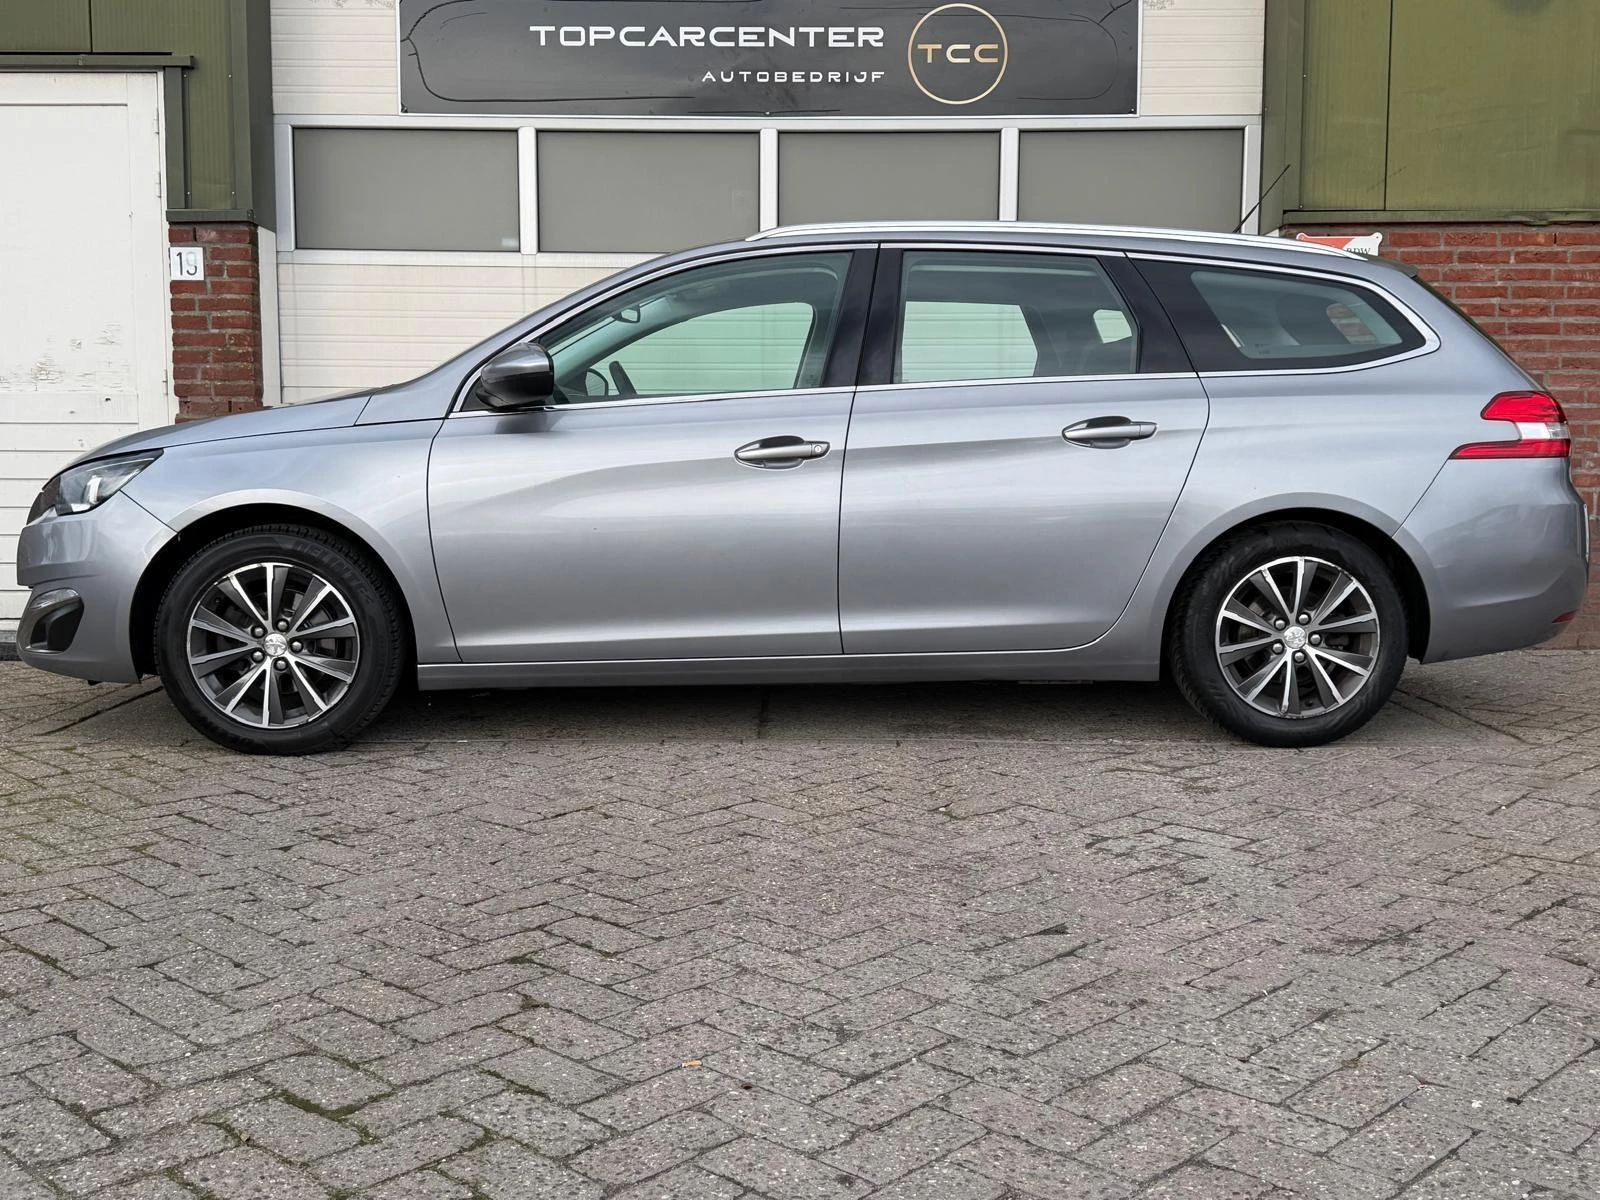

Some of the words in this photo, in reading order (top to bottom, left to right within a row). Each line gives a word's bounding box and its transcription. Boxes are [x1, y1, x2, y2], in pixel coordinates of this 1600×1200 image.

[529, 25, 885, 47] TOPCARCENTER
[917, 43, 999, 64] TCC
[701, 71, 885, 83] AUTOBEDRIJF
[176, 251, 198, 276] 19
